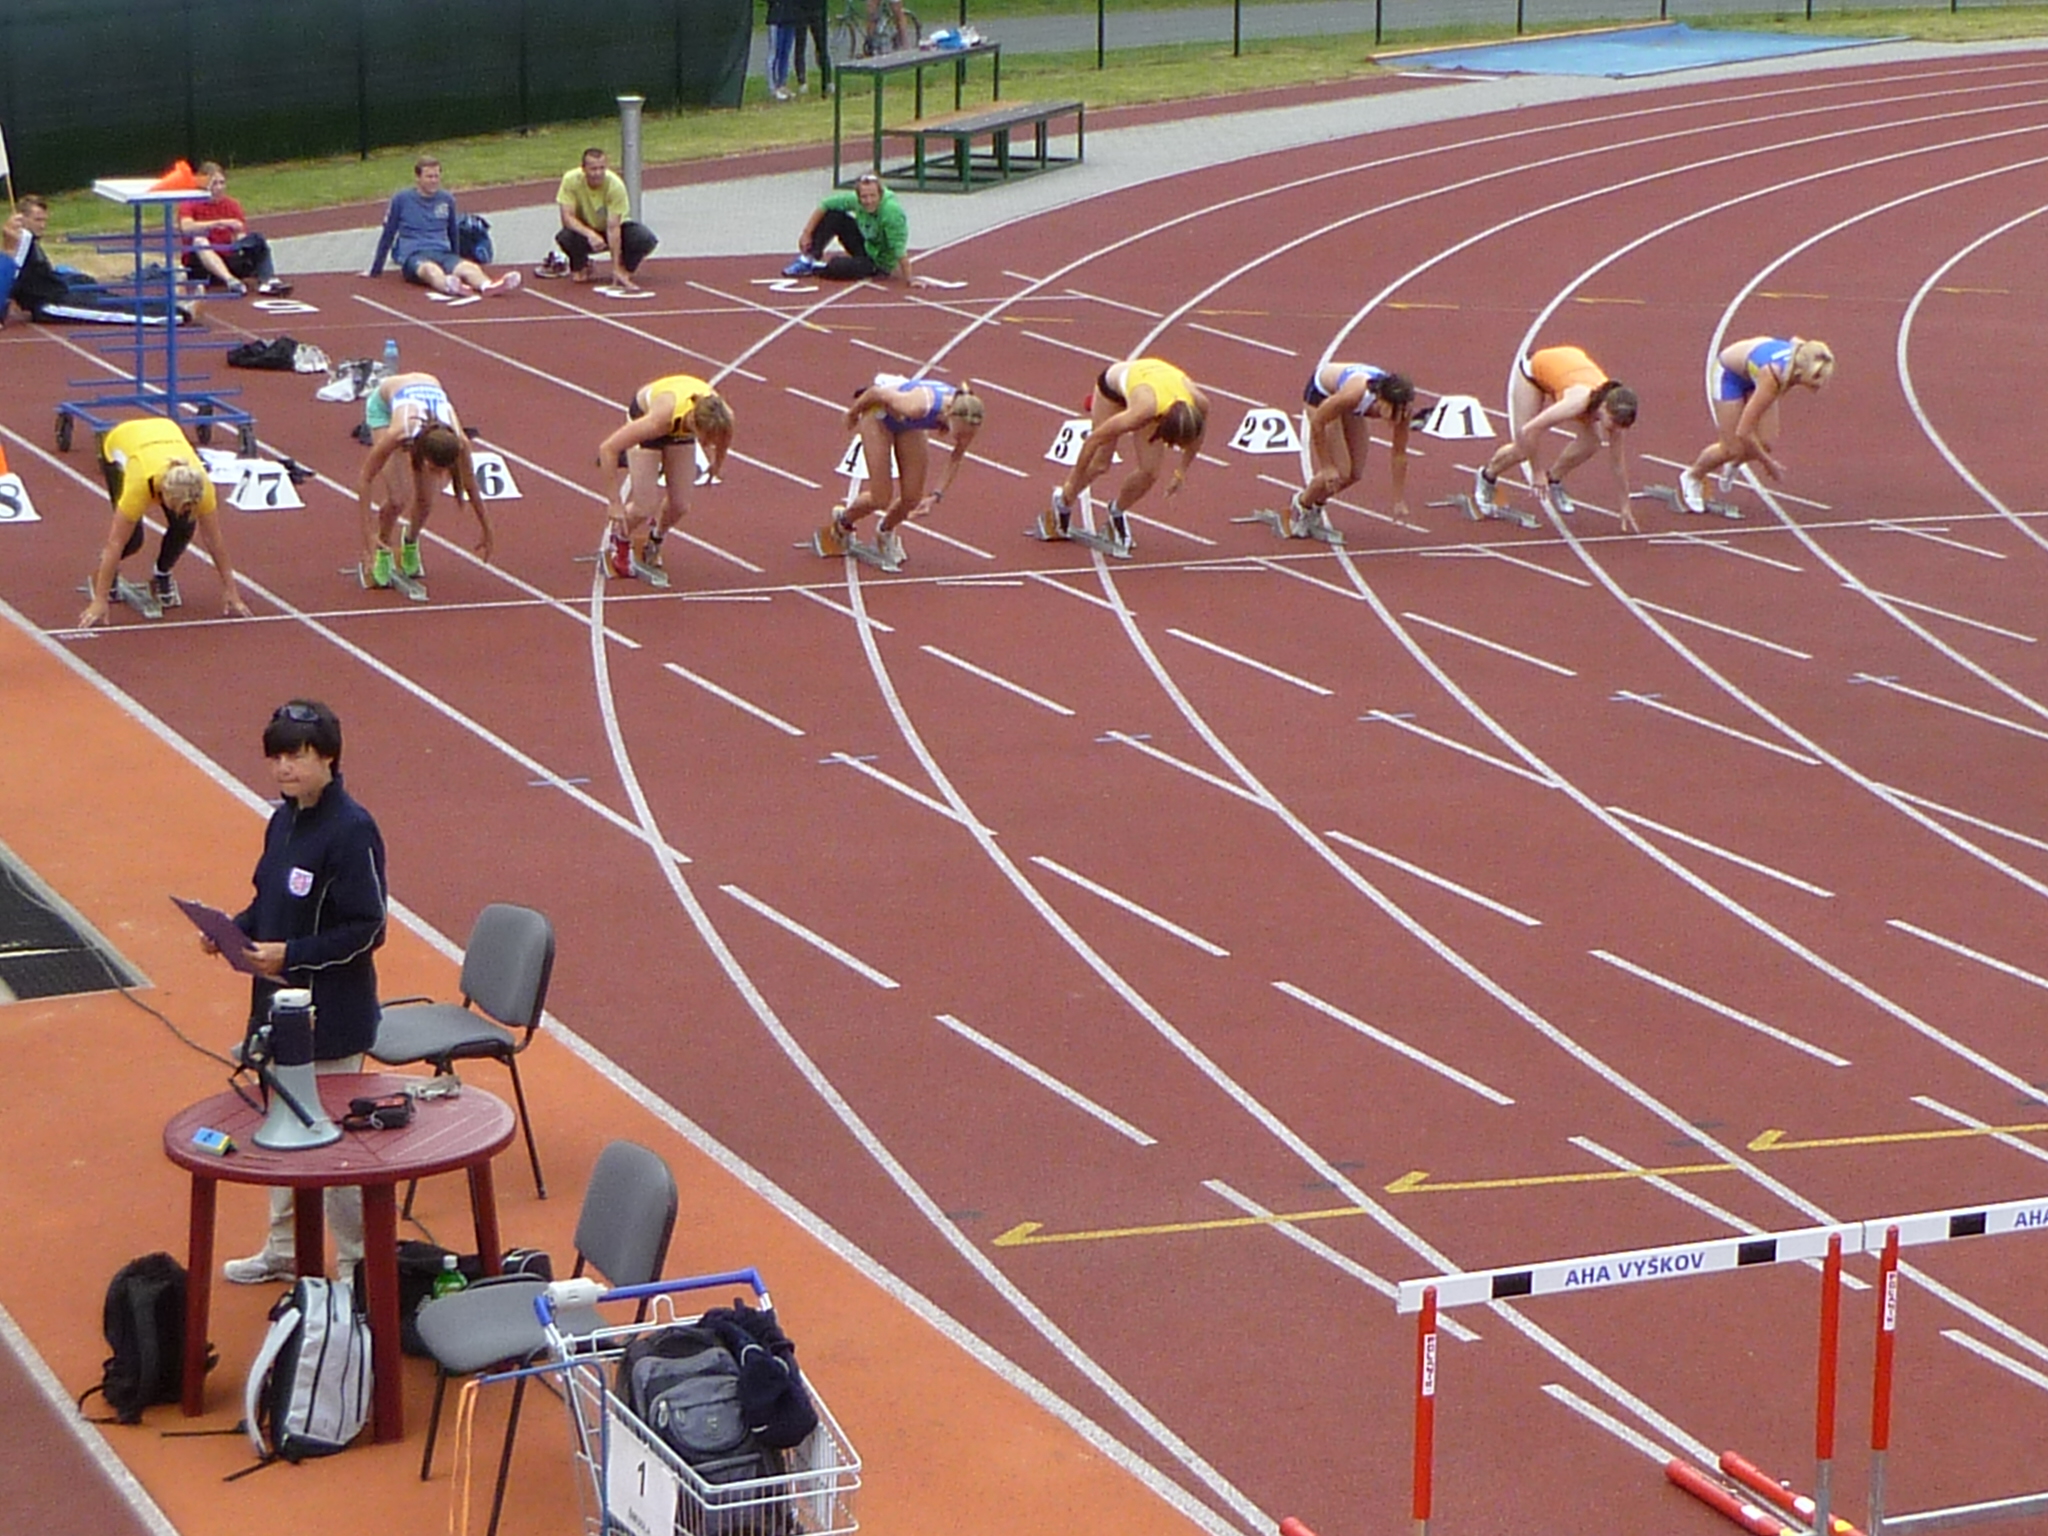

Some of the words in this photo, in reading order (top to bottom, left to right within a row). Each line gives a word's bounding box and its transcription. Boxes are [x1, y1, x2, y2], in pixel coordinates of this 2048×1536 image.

[845, 441, 863, 473] 4
[1054, 427, 1074, 460] 3
[258, 472, 282, 507] 7
[476, 462, 505, 497] 6
[0, 483, 23, 519] 8
[1564, 1265, 1611, 1287] AHA
[1618, 1251, 1705, 1279] VYŠKOV
[637, 1460, 646, 1498] 1
